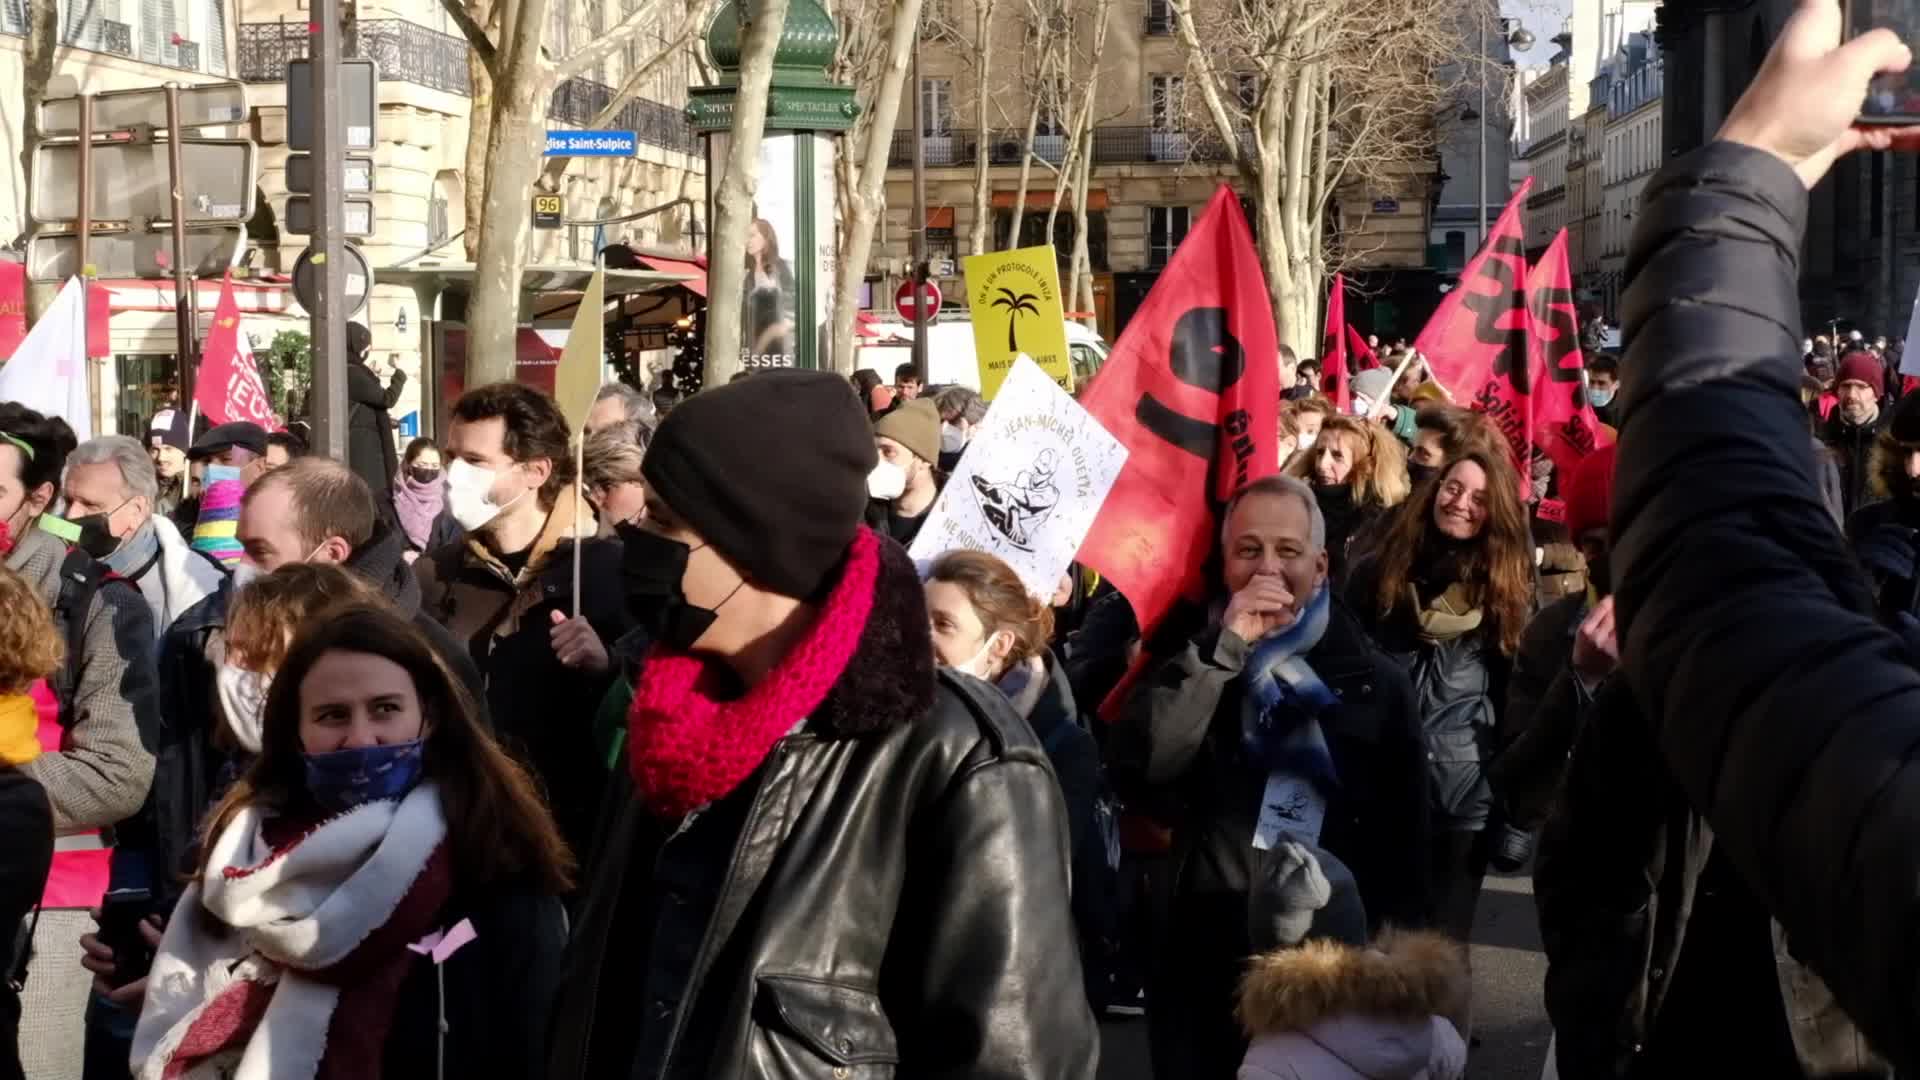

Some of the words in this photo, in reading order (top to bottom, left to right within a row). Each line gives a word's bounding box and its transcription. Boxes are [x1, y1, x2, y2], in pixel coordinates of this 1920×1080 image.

[786, 102, 841, 113] SPECTACLES
[568, 137, 632, 152] Saint-Sulpice
[538, 198, 557, 211] 96
[996, 262, 1040, 280] PROTOCOLE
[742, 353, 793, 368] ESSES
[988, 359, 1006, 370] MAIS
[1004, 413, 1075, 448] JEAN-MICHEL
[943, 517, 960, 536] NE
